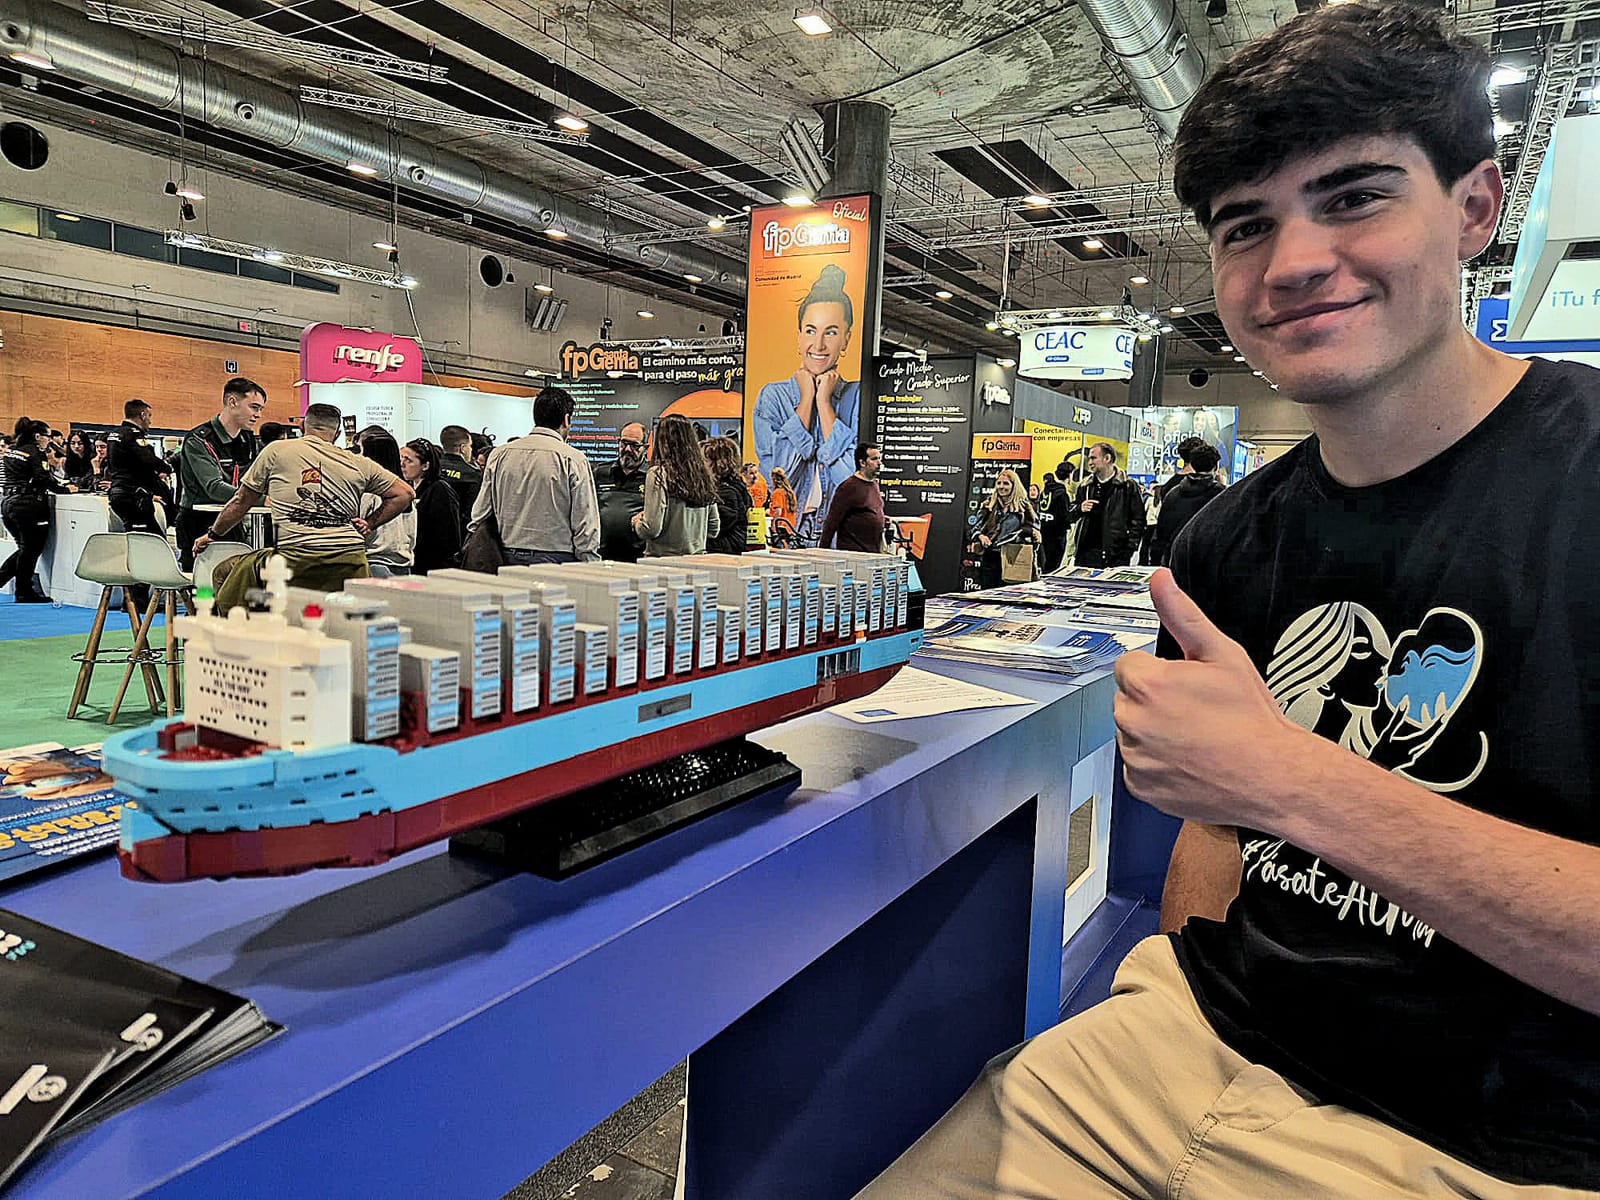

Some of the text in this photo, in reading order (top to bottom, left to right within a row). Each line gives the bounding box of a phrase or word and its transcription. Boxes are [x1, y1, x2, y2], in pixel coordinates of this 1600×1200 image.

[832, 201, 866, 222] Oficial
[1034, 331, 1087, 351] CEAC
[334, 344, 405, 373] renfe
[642, 354, 736, 367] El camino más corto,
[644, 371, 664, 381] para
[665, 370, 675, 380] el
[675, 370, 697, 381] paso
[698, 370, 719, 383] más
[934, 373, 970, 391] Superior
